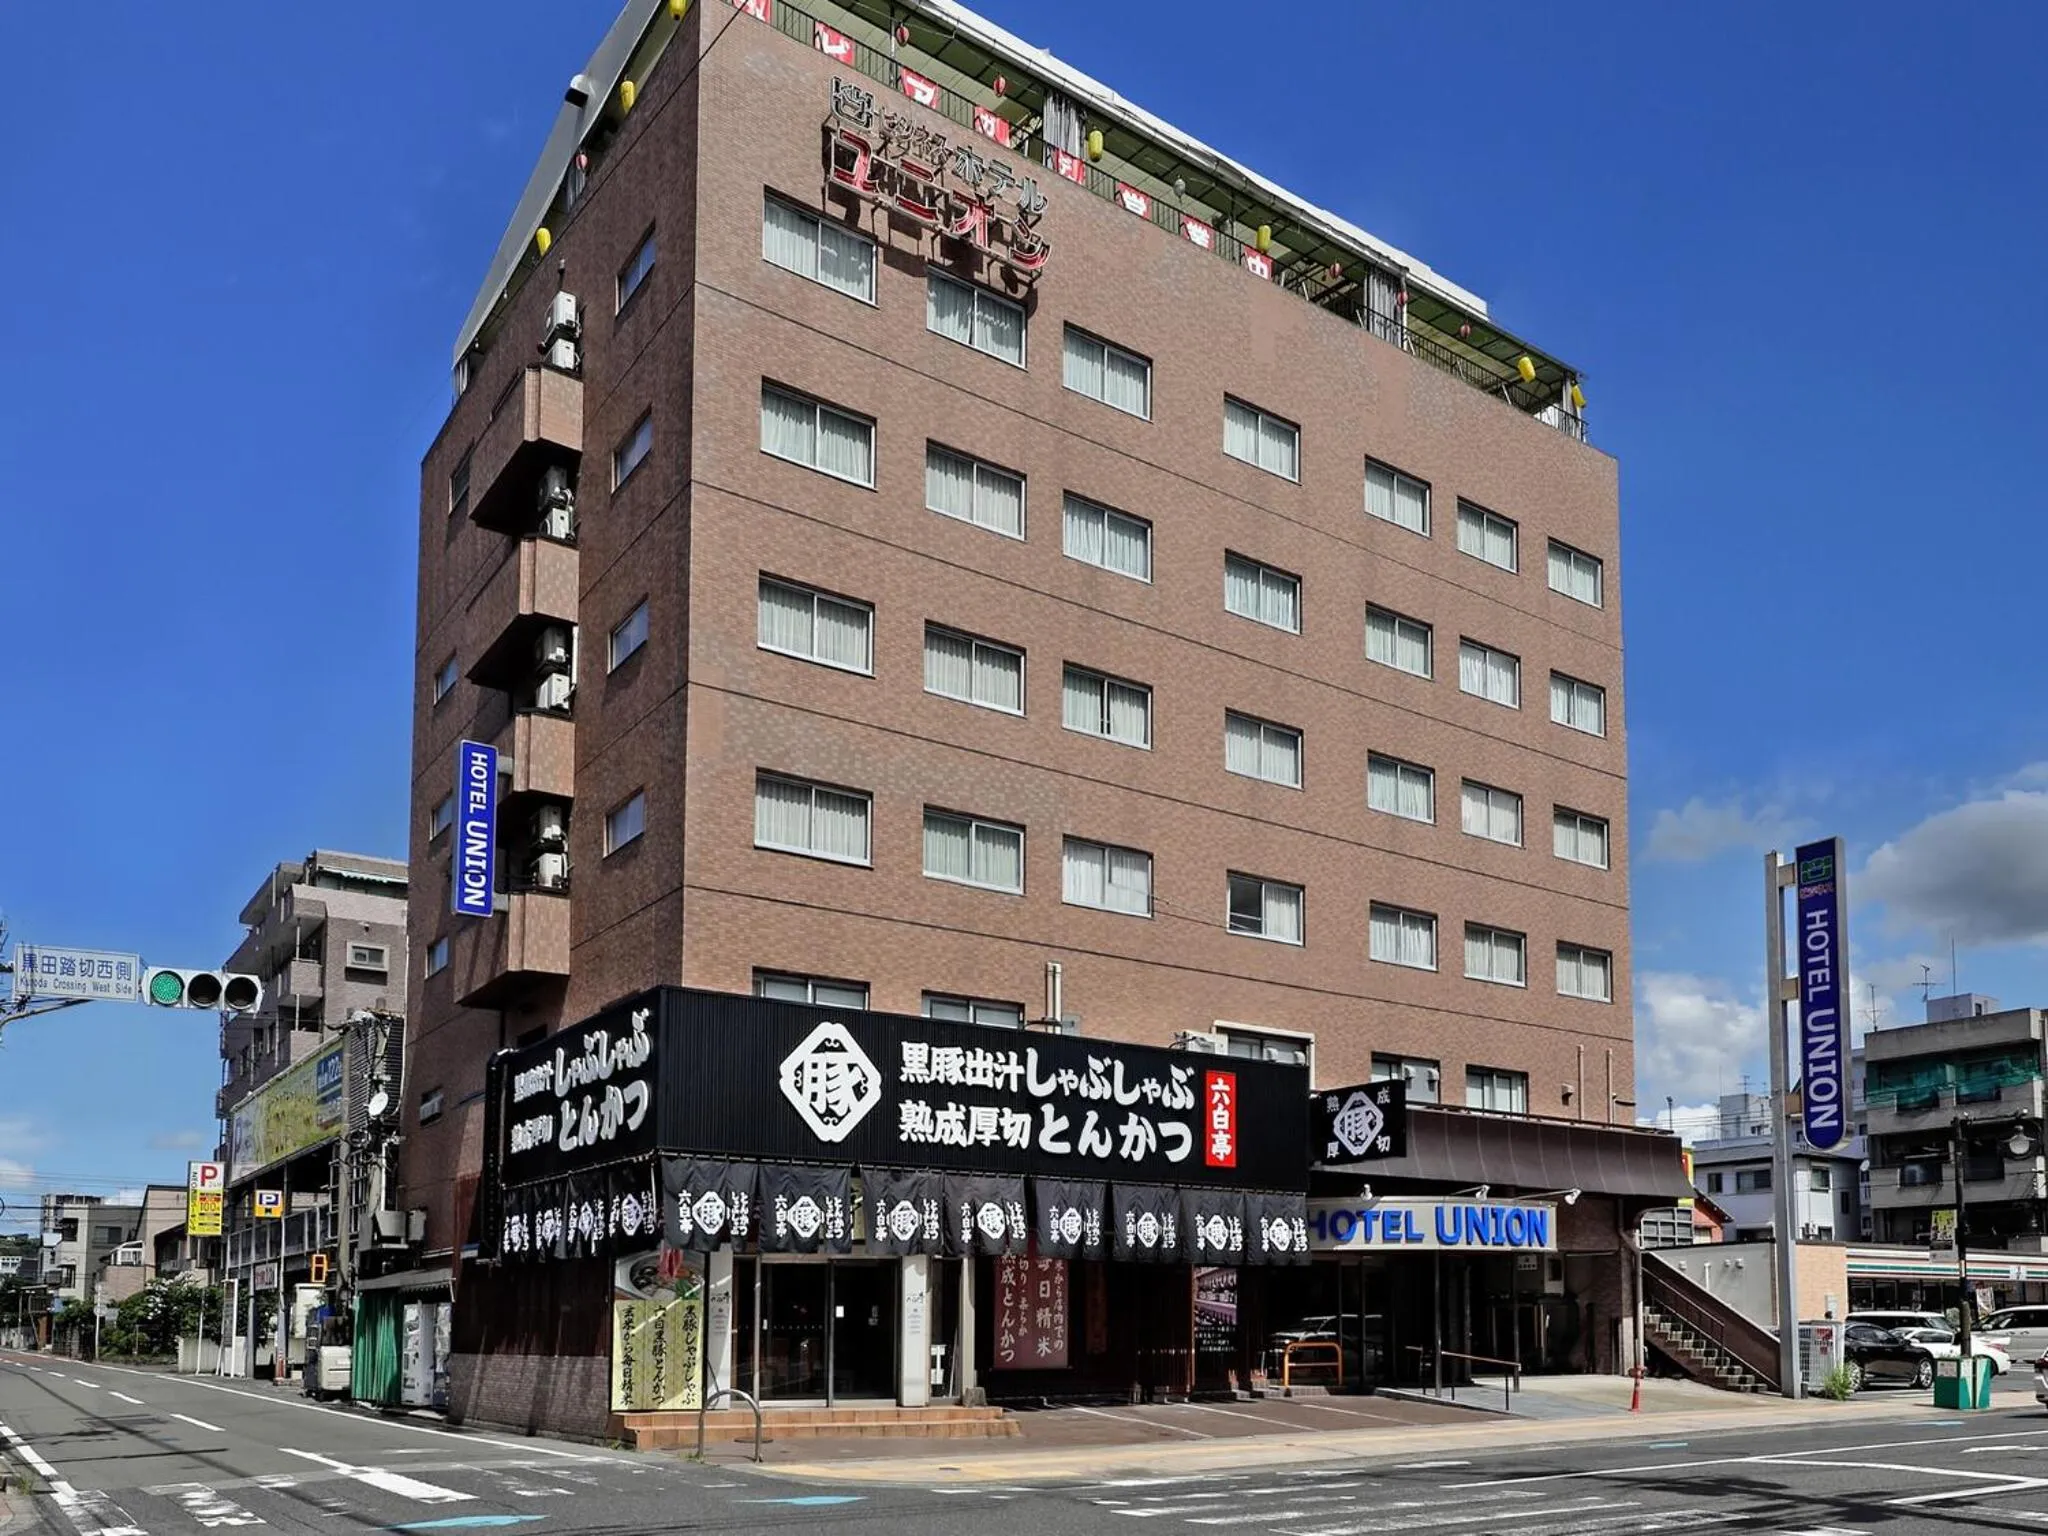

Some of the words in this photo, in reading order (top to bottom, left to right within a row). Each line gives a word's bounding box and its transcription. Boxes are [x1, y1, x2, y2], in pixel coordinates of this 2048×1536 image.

[831, 128, 1051, 270] ユニオン
[469, 752, 488, 814] HOTEL
[464, 823, 488, 907] UNION
[22, 953, 132, 981] 黒田踏切西側
[1805, 908, 1830, 1002] HOTEL
[53, 979, 87, 993] Crossing
[92, 982, 111, 993] West
[115, 984, 132, 995] Side
[900, 1040, 1195, 1110] 黒豚出汁しゃぶしゃぶ
[1807, 1007, 1839, 1130] UNION
[1376, 1086, 1391, 1105] 成
[898, 1098, 1193, 1163] 熟成厚切とんかつ
[1210, 1077, 1233, 1161] 六白亭
[1326, 1140, 1340, 1159] 厚
[1375, 1135, 1391, 1153] 切
[202, 1166, 217, 1187] P
[678, 1190, 693, 1235] 六白亭
[774, 1195, 788, 1238] 六白亭
[875, 1199, 888, 1241] 六白亭
[961, 1202, 972, 1243] 六白亭
[1049, 1206, 1060, 1243] 六白亭
[1126, 1211, 1136, 1248] 六白亭
[1435, 1205, 1548, 1248] UNION
